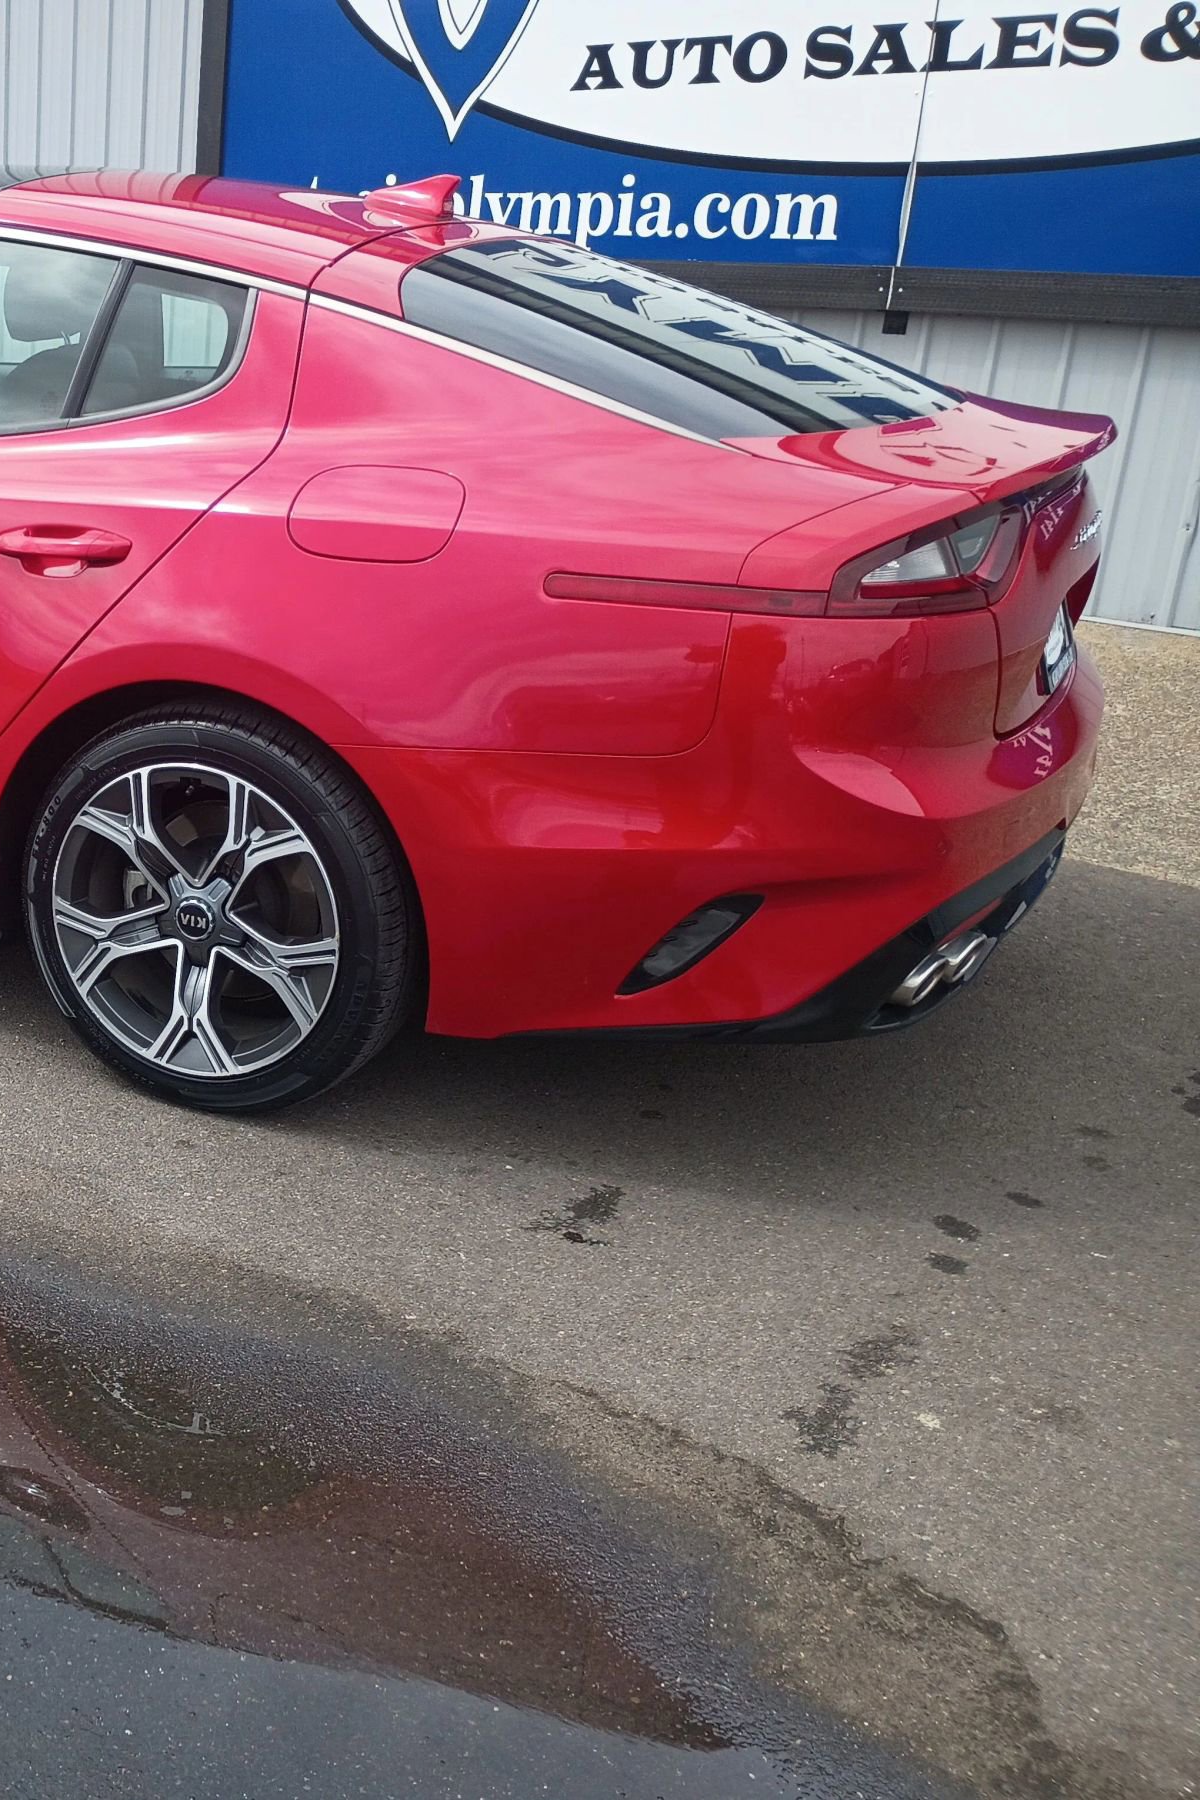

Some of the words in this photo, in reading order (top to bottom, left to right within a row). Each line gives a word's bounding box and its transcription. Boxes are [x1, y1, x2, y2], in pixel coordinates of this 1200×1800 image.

[570, 31, 788, 92] AUTO
[803, 7, 1120, 80] SALES
[1140, 0, 1200, 63] &
[311, 173, 837, 249] lympia.com
[180, 912, 207, 930] KIA
